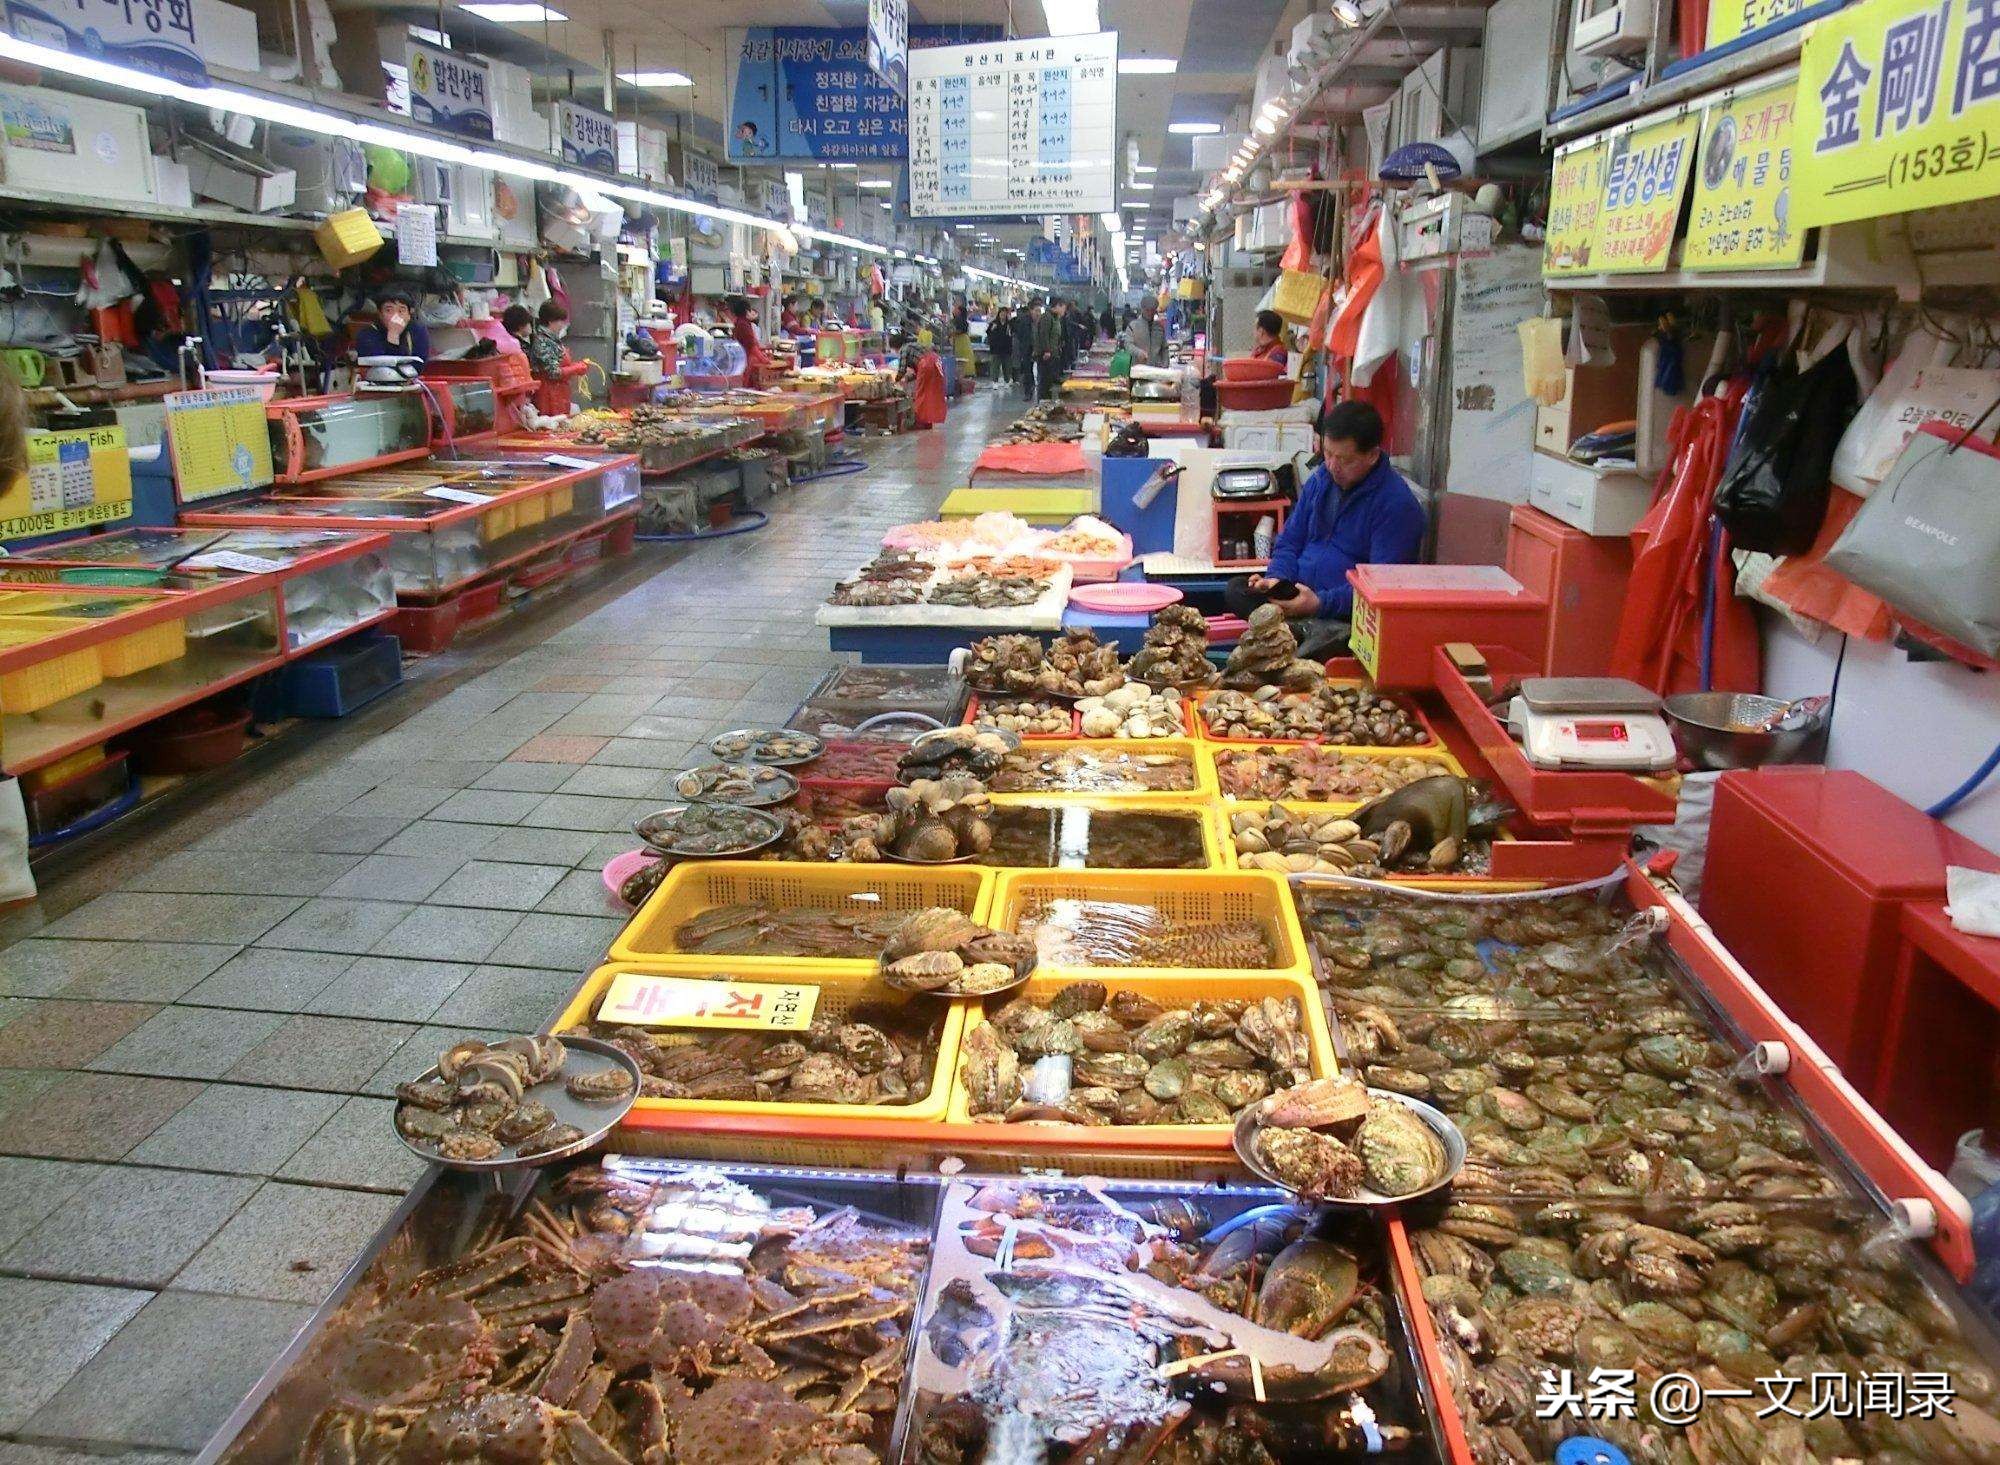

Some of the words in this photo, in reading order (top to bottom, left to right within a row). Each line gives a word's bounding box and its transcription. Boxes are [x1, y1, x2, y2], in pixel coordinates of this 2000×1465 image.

[815, 72, 857, 89] 정직한
[943, 76, 967, 89] 원산지
[977, 74, 1001, 86] 음식명
[1044, 69, 1068, 81] 원산지
[1080, 66, 1104, 79] 음식명
[815, 95, 857, 113] 친절한
[789, 119, 817, 135] 다시
[823, 119, 850, 135] 오고
[857, 119, 884, 136] 싶은
[1739, 102, 1796, 143] 조개구
[1887, 131, 1987, 188] (153호)
[89, 430, 114, 447] Fish
[1904, 515, 1959, 547] BEANPOLE
[771, 989, 800, 1025] 자연산
